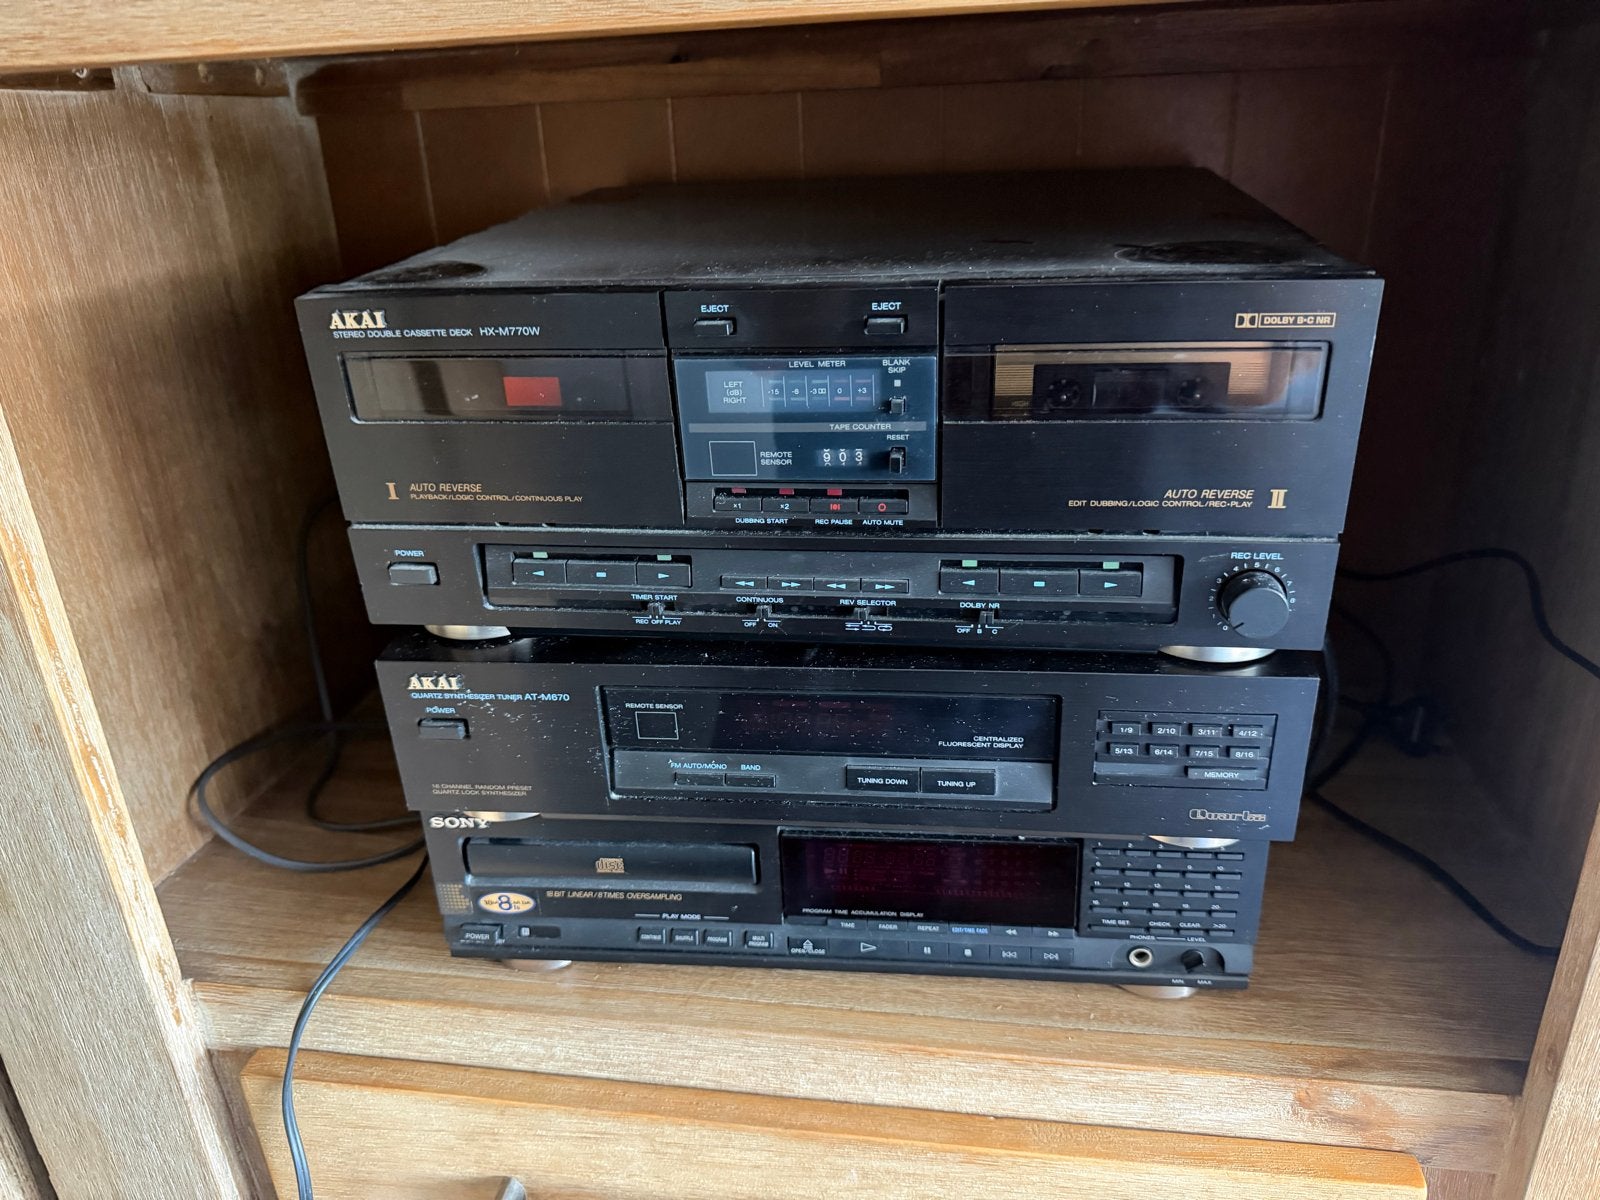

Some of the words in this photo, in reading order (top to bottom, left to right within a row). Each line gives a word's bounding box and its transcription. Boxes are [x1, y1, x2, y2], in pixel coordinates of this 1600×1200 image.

[700, 304, 730, 314] EJECT
[871, 301, 902, 312] EJECT
[330, 310, 386, 329] AKAI
[1263, 316, 1295, 325] DOLBY
[1315, 316, 1331, 325] NR
[333, 330, 365, 338] STEREO
[367, 329, 402, 338] DOUBLE
[403, 329, 447, 338] CASSETTE
[449, 328, 473, 337] DECK
[479, 326, 541, 337] HX-M770W
[788, 361, 815, 369] LEVEL
[817, 360, 847, 368] METER
[882, 358, 911, 367] BLANK
[887, 366, 907, 375] SKIP
[723, 381, 743, 389] LEFT
[726, 389, 743, 397] (dB)
[836, 387, 843, 395] 0
[722, 397, 747, 405] RIGHT
[829, 423, 850, 432] TAPE
[852, 423, 892, 431] COUNTER
[886, 434, 910, 442] RESET
[760, 451, 793, 459] REMOTE
[760, 458, 793, 466] SENSOR
[409, 483, 437, 493] AUTO
[439, 484, 483, 493] REVERSE
[1163, 489, 1198, 499] AUTO
[1200, 489, 1255, 499] REVERSE
[476, 495, 564, 503] CONTROL/CONTINUOUS
[735, 517, 766, 525] DUBBING
[766, 517, 789, 525] START
[815, 518, 830, 526] REC
[831, 518, 853, 526] PAUSE
[862, 518, 883, 526] AUTO
[884, 518, 904, 526] MUTE
[395, 549, 425, 558] POWER
[1230, 552, 1252, 560] REC
[1253, 552, 1284, 561] LEVEL
[735, 596, 784, 604] CONTINUOUS
[839, 598, 855, 606] REV
[856, 598, 897, 607] SELECTOR
[743, 620, 757, 628] OFF
[407, 674, 462, 690] AKAI
[426, 706, 456, 714] POWER
[1157, 727, 1176, 735] 2/10
[1197, 728, 1216, 736] 3/11
[1238, 729, 1258, 738] 4/12
[973, 735, 1024, 743] CENTRALIZED
[938, 740, 991, 748] FLUORESCENT
[993, 741, 1024, 749] DISPLAY
[1115, 747, 1134, 755] 5/13
[1154, 748, 1173, 756] 6/14
[1195, 750, 1213, 758] 7/15
[1204, 771, 1240, 779] MEMORY
[965, 780, 976, 788] UP
[429, 816, 490, 829] SONY
[626, 892, 682, 901] OVERSAMPLING
[465, 932, 490, 940] POWER
